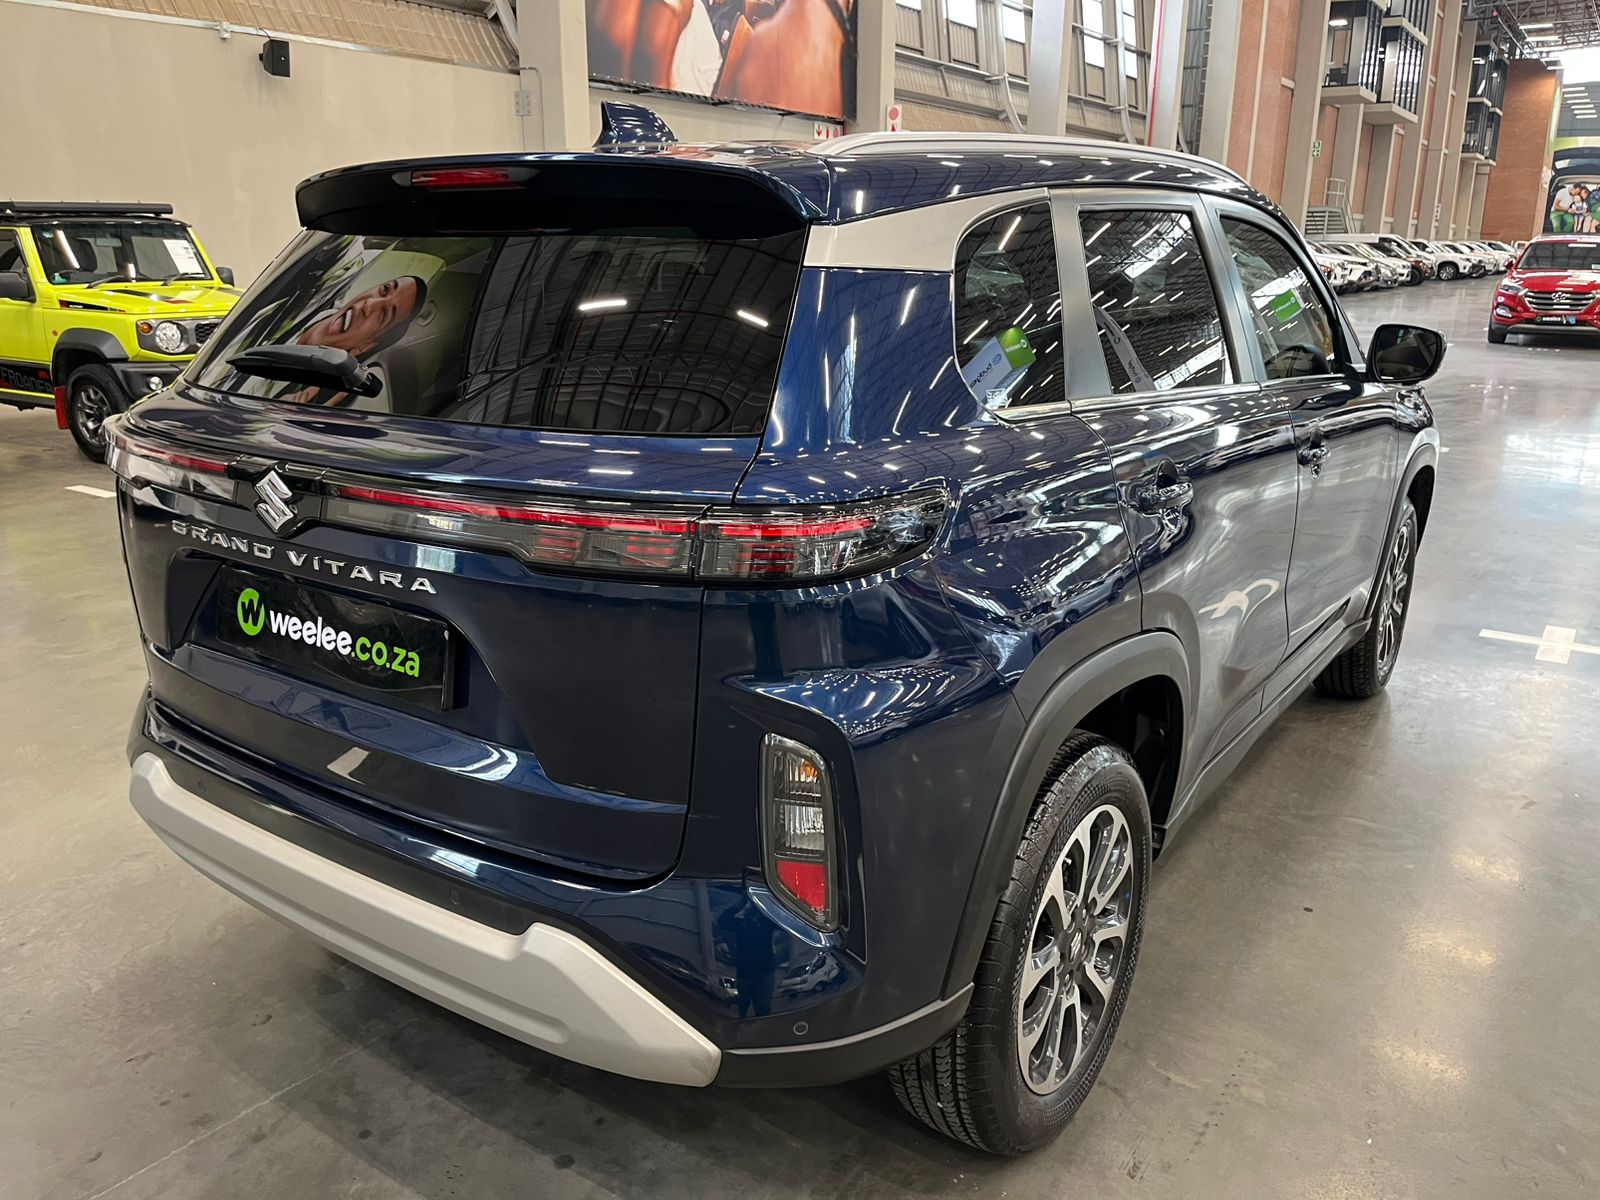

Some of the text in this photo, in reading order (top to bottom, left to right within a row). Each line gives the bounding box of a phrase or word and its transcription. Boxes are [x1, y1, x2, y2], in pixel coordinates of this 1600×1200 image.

[171, 519, 438, 595] GRAND VITARA
[269, 609, 421, 678] weelee.co.za
